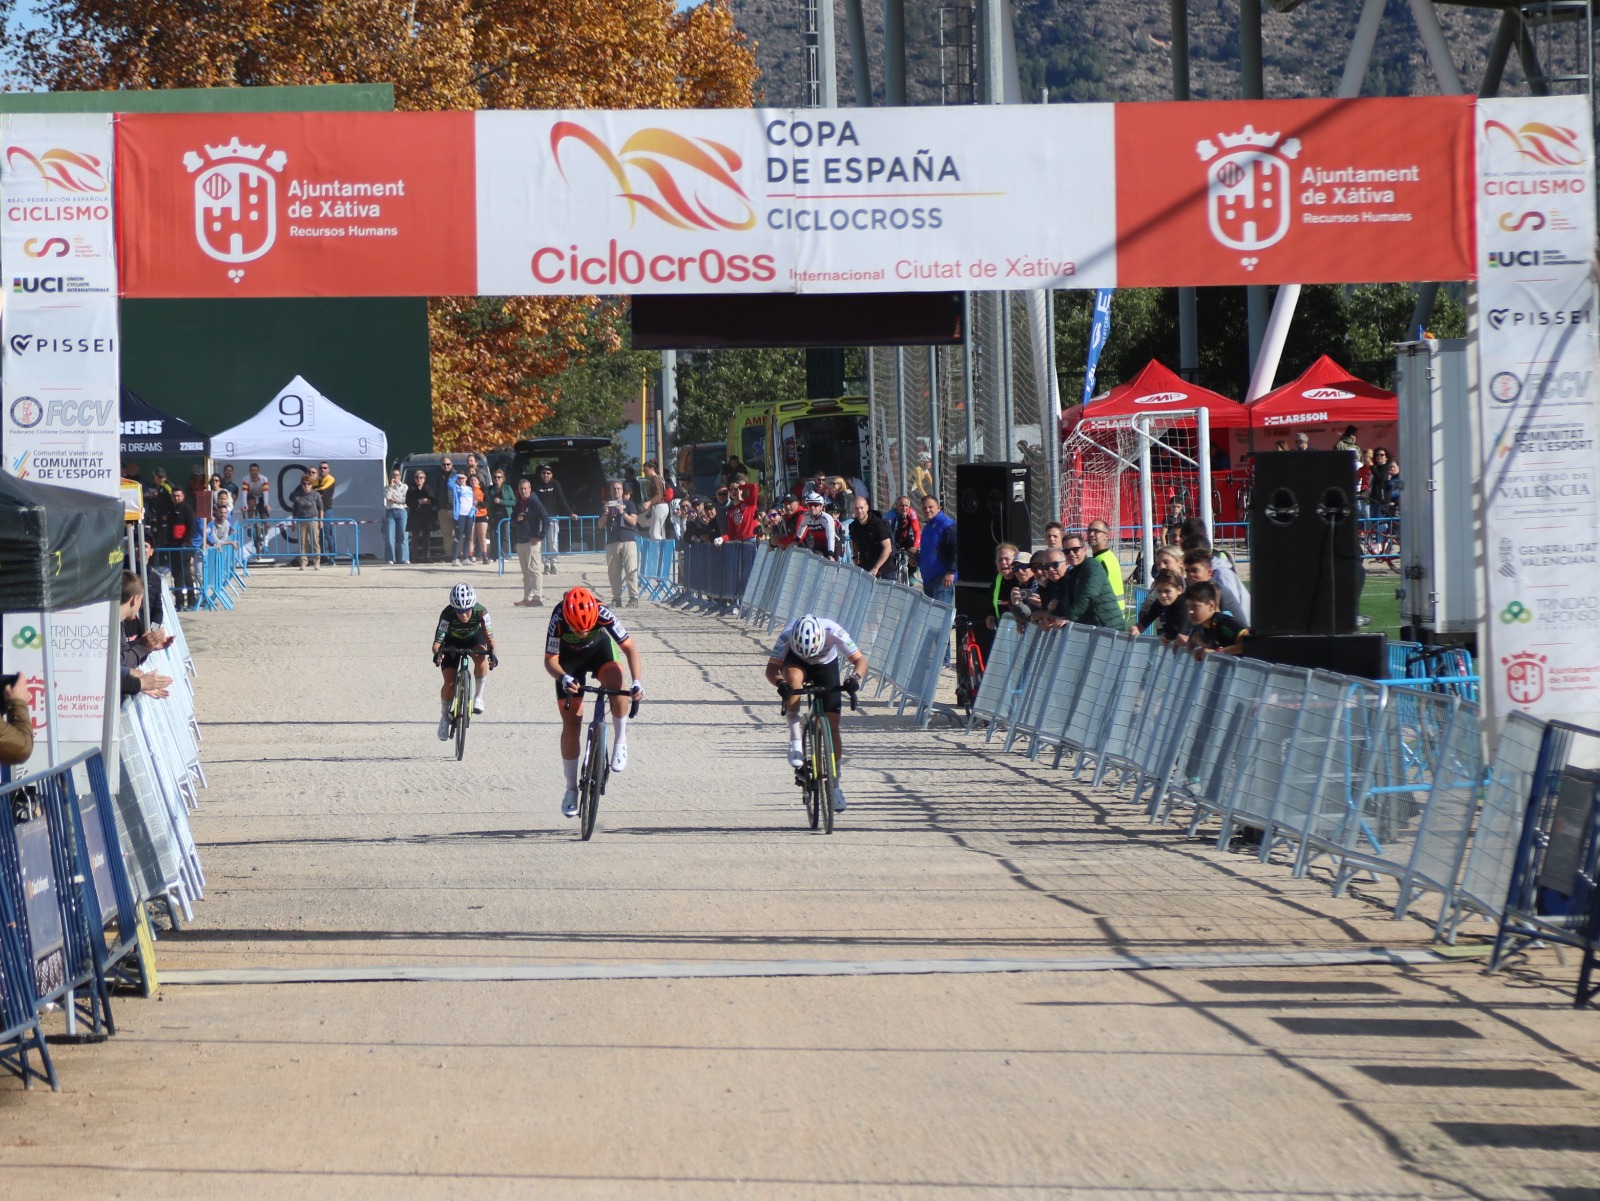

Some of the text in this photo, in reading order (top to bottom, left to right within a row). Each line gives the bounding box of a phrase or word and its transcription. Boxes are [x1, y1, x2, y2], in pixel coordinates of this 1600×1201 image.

[767, 120, 860, 147] COPA
[767, 149, 960, 184] DE ESPAÑA
[1301, 165, 1420, 186] Ajuntament
[288, 179, 405, 200] Ajuntament
[1484, 179, 1585, 196] CICLISMO
[1301, 187, 1395, 205] de Xàtiva
[8, 206, 109, 222] CICLISMO
[288, 200, 380, 218] de Xàtiva
[767, 207, 943, 231] CICLOCROSS
[1303, 212, 1412, 224] Recursos Humans
[290, 225, 398, 237] Recursos Humans
[790, 268, 885, 280] Internacional
[895, 259, 962, 279] Ciutat
[969, 259, 997, 278] de
[1004, 254, 1076, 278] Xàtiva
[1499, 250, 1539, 268] UCI
[23, 277, 63, 293] UCI
[1513, 310, 1591, 326] PISSEI
[37, 338, 113, 353] PISSEI
[1141, 393, 1180, 403] JMP
[1308, 390, 1348, 398] JMP
[46, 399, 114, 427] FCCV
[279, 394, 304, 427] 9
[1279, 411, 1328, 425] LARSSON
[1515, 430, 1584, 443] COMUNITAT
[128, 442, 162, 452] DREAMS
[292, 437, 301, 455] 9
[359, 437, 368, 455] 9
[33, 457, 103, 468] COMUNITAT
[38, 468, 112, 479] DE L'ESPORT
[58, 702, 99, 711] de Xàtiva
